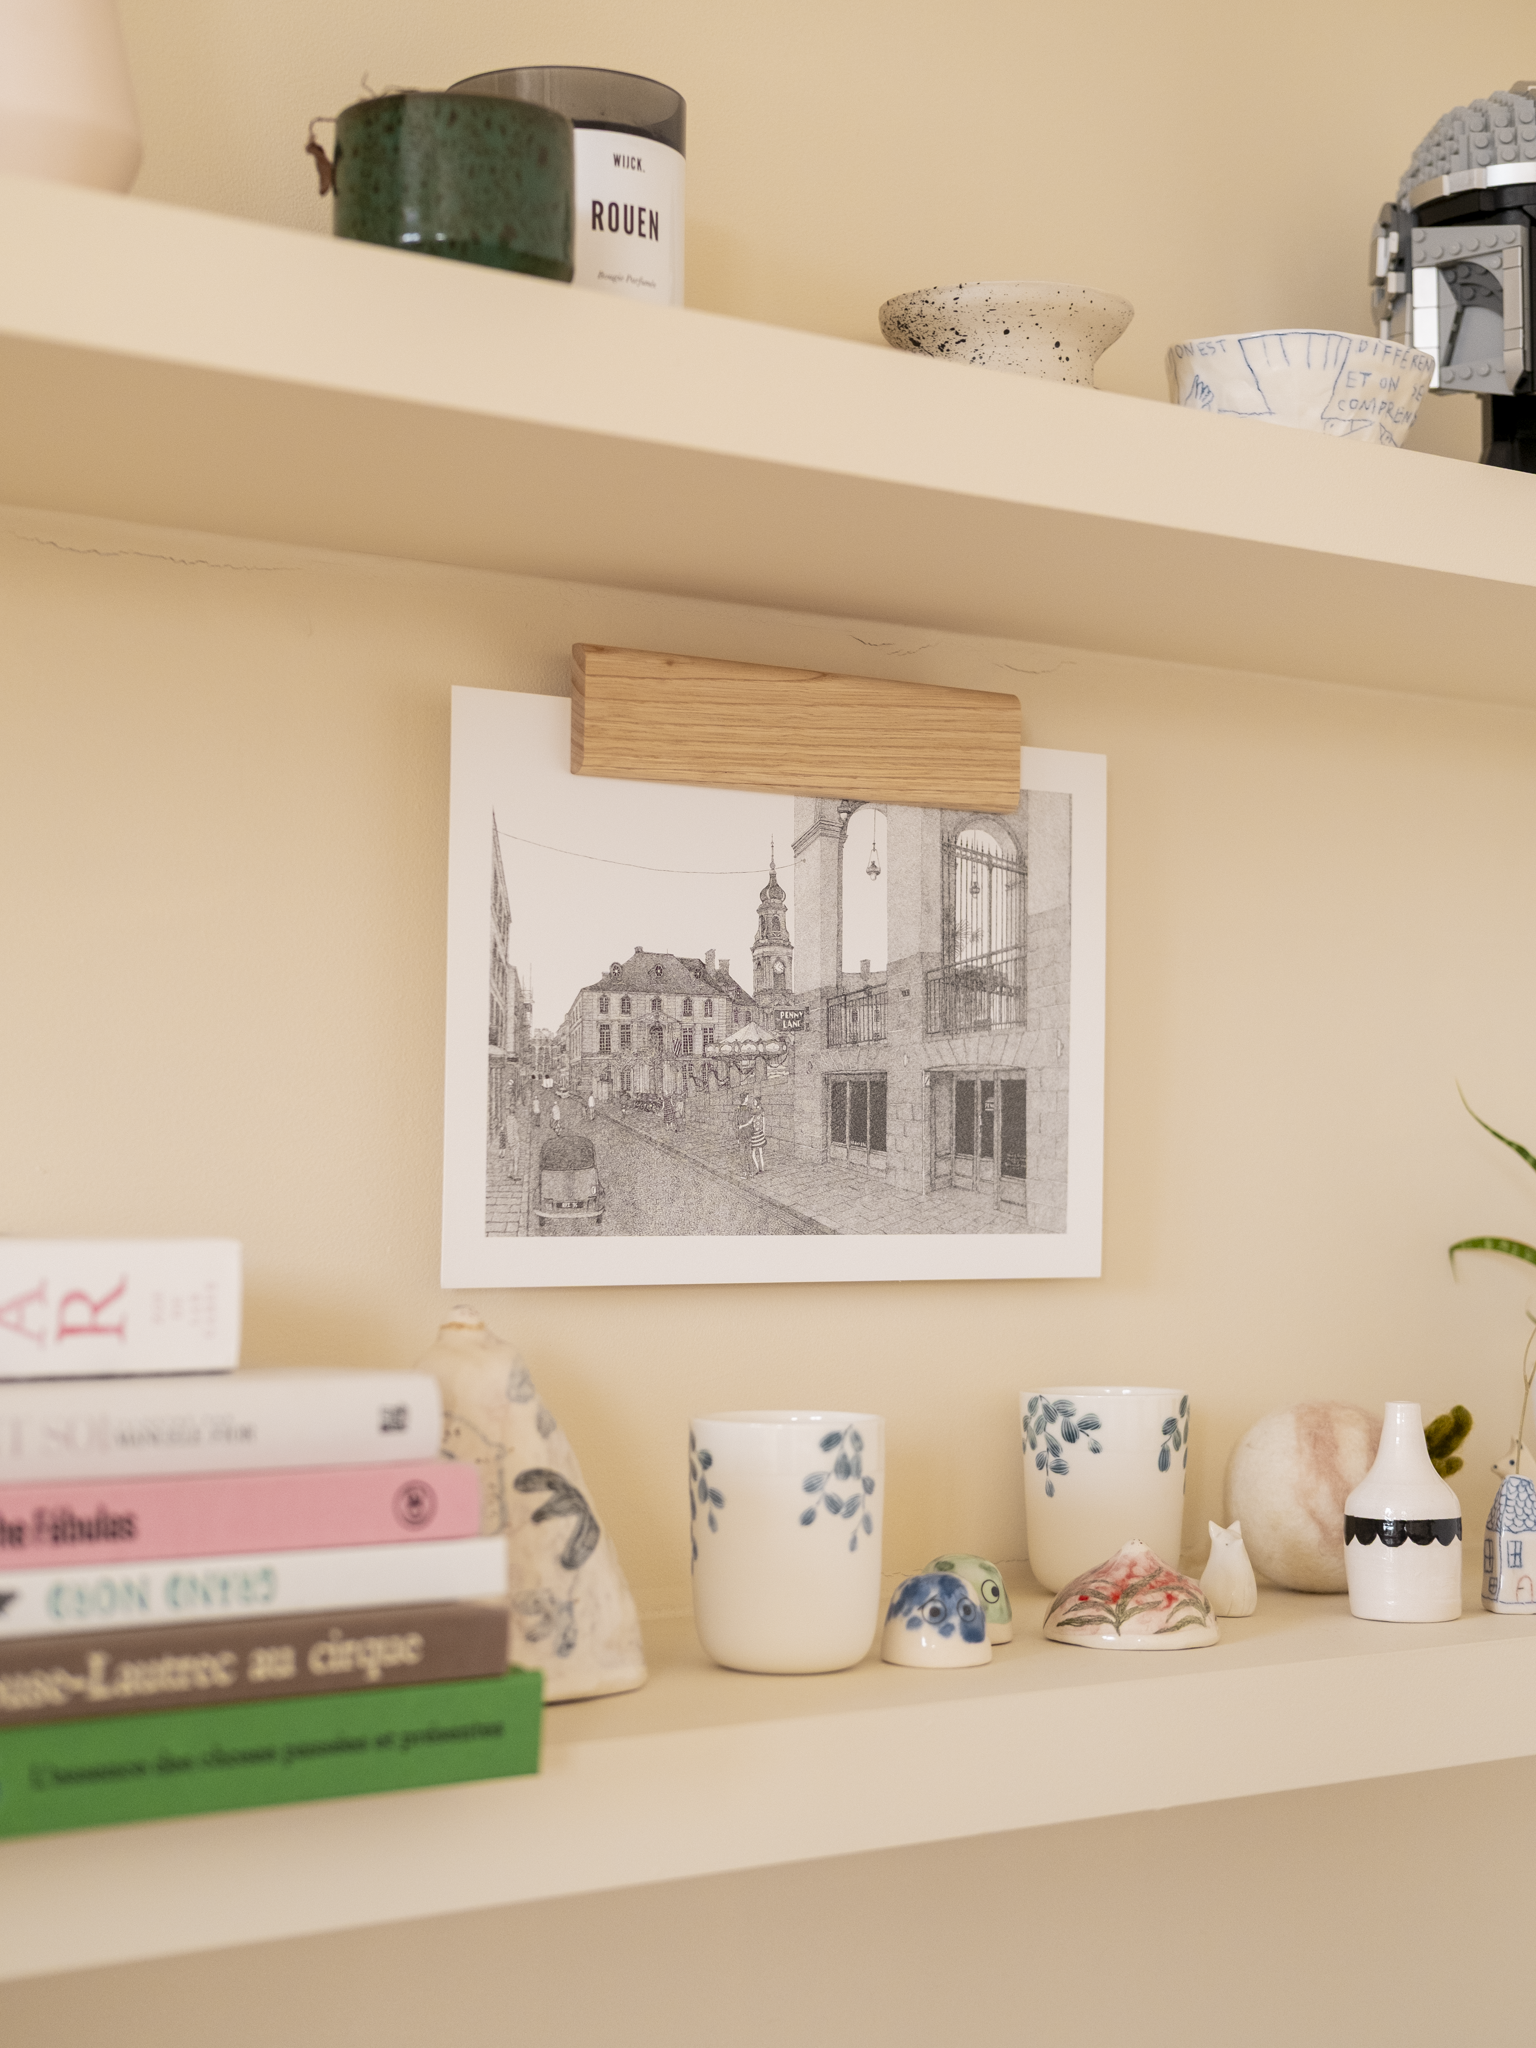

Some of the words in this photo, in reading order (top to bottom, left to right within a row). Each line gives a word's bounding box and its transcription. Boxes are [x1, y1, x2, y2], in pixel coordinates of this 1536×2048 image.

[613, 152, 646, 173] WIJCK.
[591, 200, 659, 242] ROUEN
[1345, 370, 1372, 388] ET
[1379, 376, 1400, 393] ON
[780, 1011, 804, 1020] PENNY
[247, 1645, 297, 1682] au
[306, 1629, 425, 1683] cirque
[374, 1731, 396, 1749] et
